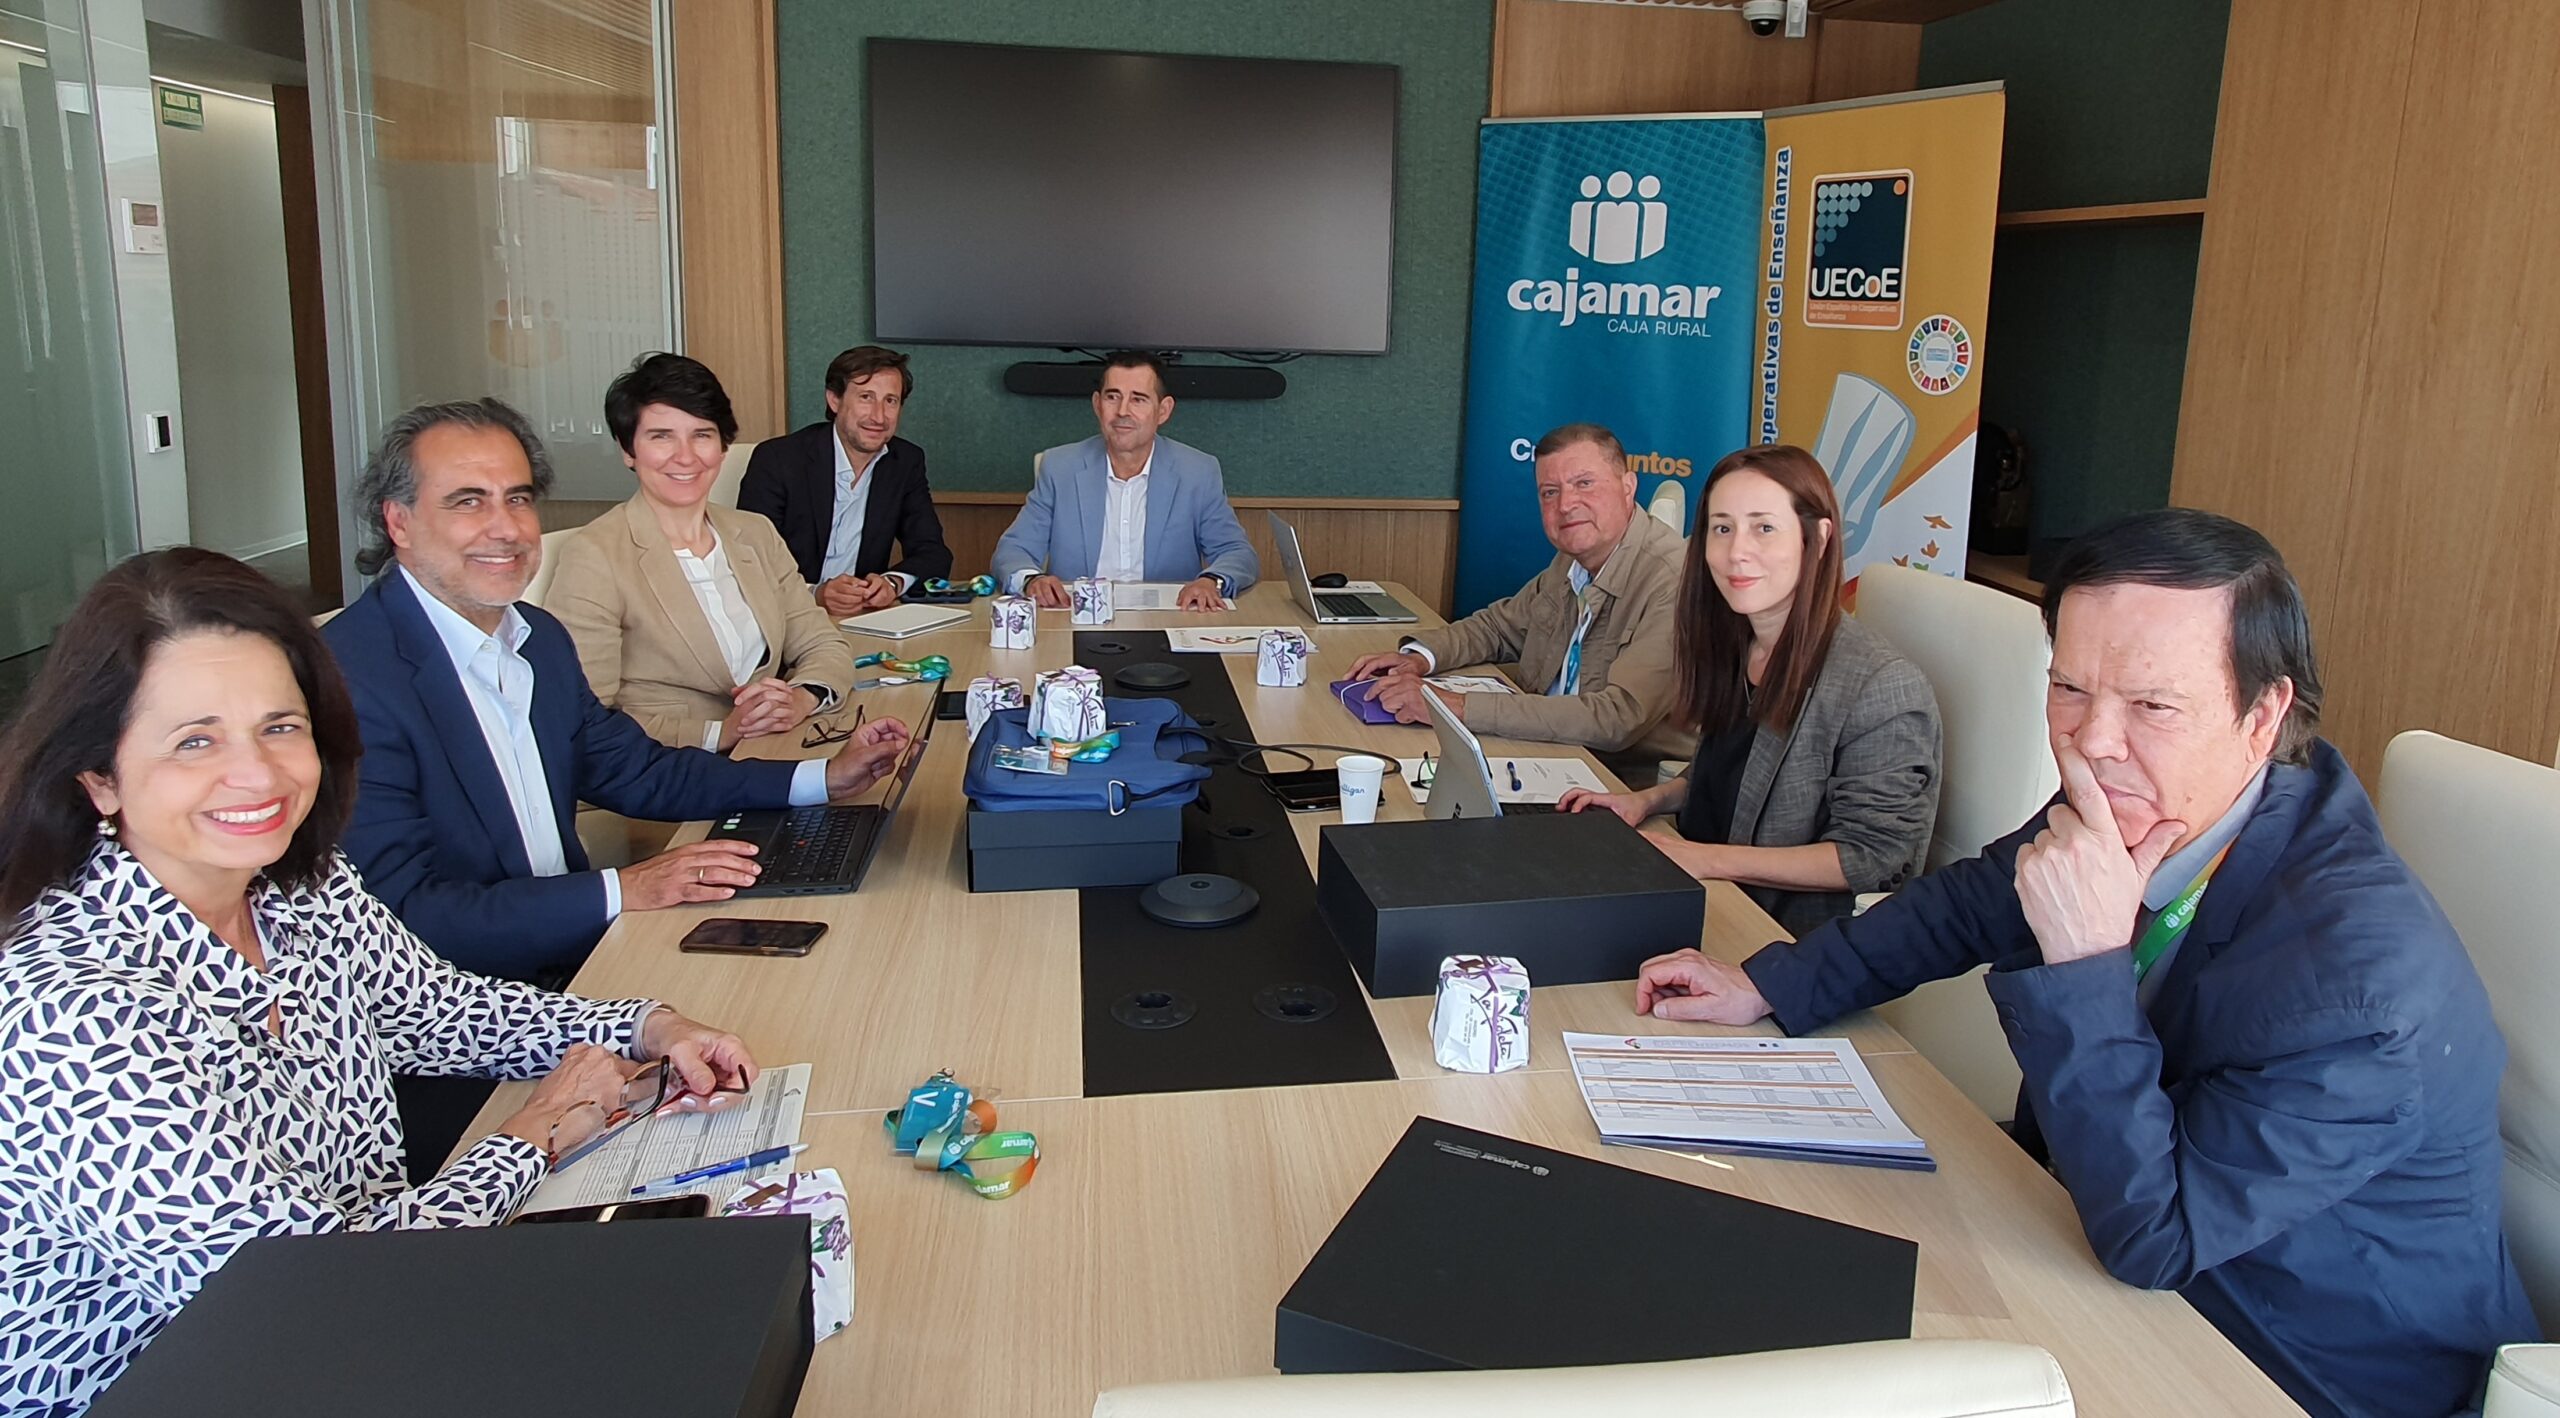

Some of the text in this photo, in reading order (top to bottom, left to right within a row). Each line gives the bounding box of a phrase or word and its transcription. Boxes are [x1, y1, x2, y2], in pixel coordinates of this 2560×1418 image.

[1507, 267, 1721, 327] cajamar
[1761, 147, 1791, 445] operativas de Enseñanza
[1811, 267, 1900, 298] UECoE
[1607, 318, 1711, 338] CAJA RURAL
[1626, 451, 1692, 477] ntos
